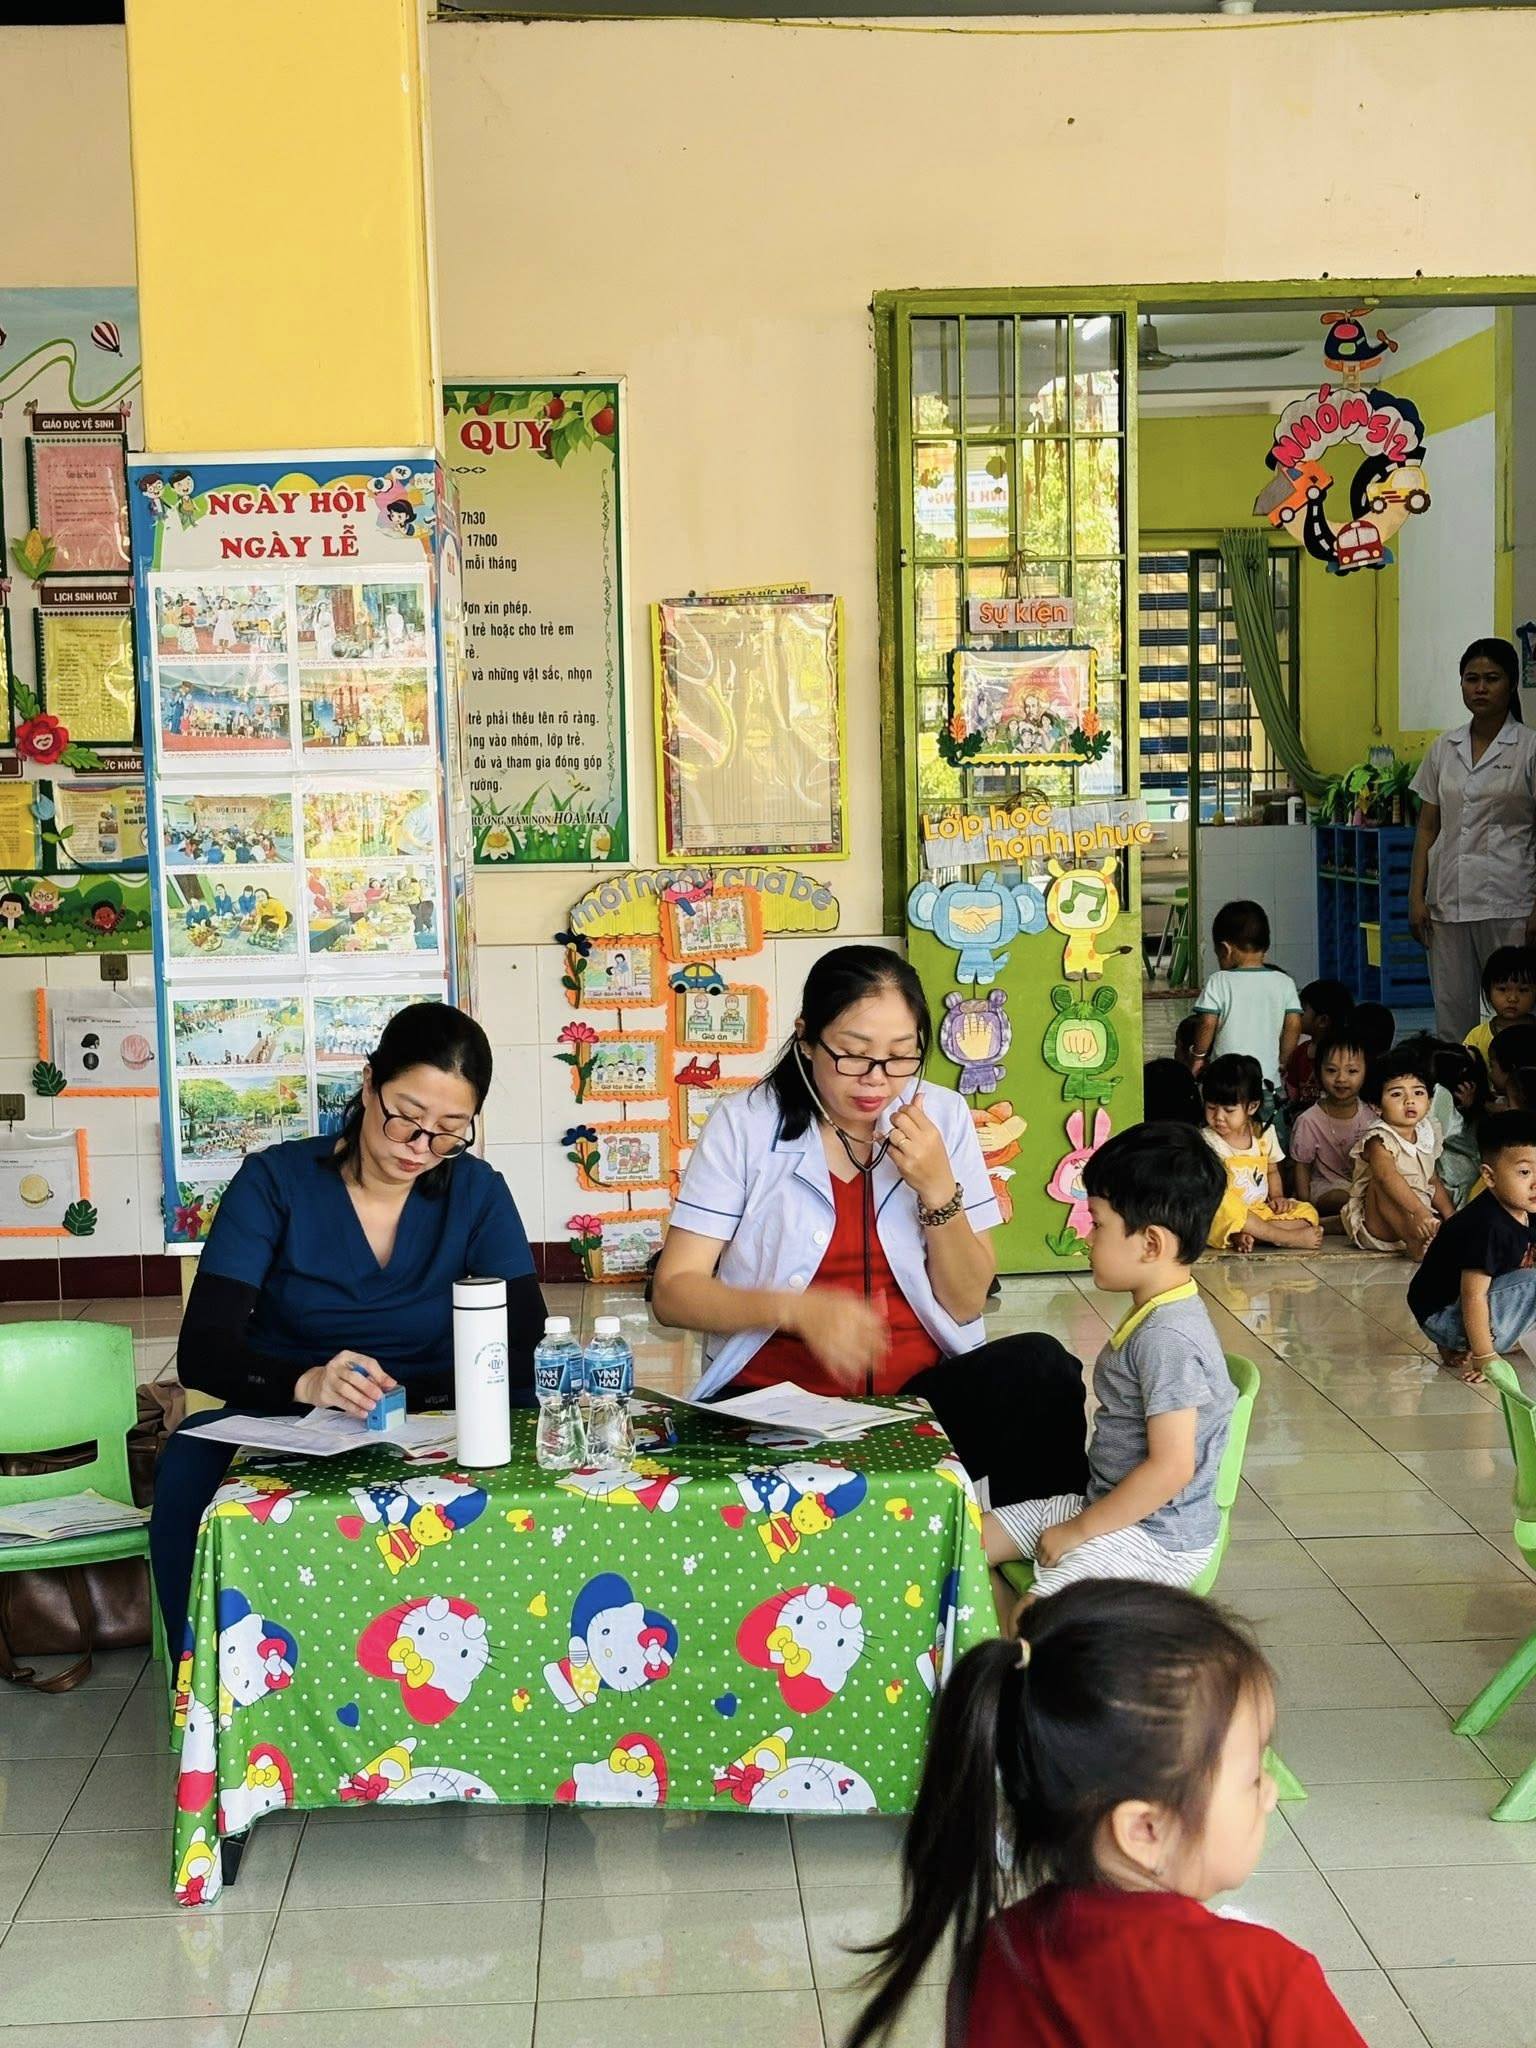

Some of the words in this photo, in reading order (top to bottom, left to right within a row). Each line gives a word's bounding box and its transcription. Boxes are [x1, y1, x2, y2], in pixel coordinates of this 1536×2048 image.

[42, 419, 61, 430] GIÁO
[95, 419, 114, 430] SINH
[460, 420, 551, 456] QUY
[1366, 414, 1408, 462] 5/2
[208, 486, 300, 515] NGÀY
[310, 485, 367, 519] HỘI
[220, 530, 312, 559] NGÀY
[321, 524, 360, 558] LỄ
[467, 533, 498, 547] 17h00
[465, 554, 485, 570] mỗi
[488, 556, 518, 572] tháng
[54, 592, 73, 605] LỊCH
[75, 592, 93, 602] SINH
[95, 591, 118, 604] HOẠT
[484, 601, 499, 614] xin
[503, 600, 532, 617] phép.
[979, 602, 1008, 629] Sự
[1014, 600, 1069, 628] kiện
[472, 621, 487, 637] trẻ
[491, 623, 515, 639] hoặc
[518, 623, 537, 637] cho
[540, 620, 554, 636] trẻ
[558, 625, 574, 636] em
[465, 643, 480, 659] rẻ.
[472, 667, 484, 681] và
[488, 666, 519, 683] những
[523, 667, 539, 683] vật
[542, 664, 564, 682] sắc,
[567, 666, 593, 683] nhọn
[468, 710, 482, 725] trẻ
[486, 710, 508, 727] phải
[512, 711, 535, 725] thêu
[538, 711, 554, 725] tên
[558, 711, 569, 724] rõ
[573, 711, 600, 727] ràng.
[489, 733, 507, 747] vào
[511, 733, 543, 748] nhóm,
[547, 732, 563, 749] lớp
[567, 731, 585, 747] trẻ.
[117, 757, 143, 770] KHỎE
[474, 755, 487, 769] đủ
[491, 755, 502, 769] và
[507, 755, 532, 769] tham
[536, 756, 551, 770] gia
[555, 755, 580, 770] đóng
[583, 754, 602, 770] góp
[470, 778, 503, 793] rường.
[471, 813, 505, 826] RƯỜNG
[531, 815, 551, 825] NON
[553, 811, 581, 825] HOA
[585, 811, 609, 825] MAI
[921, 803, 984, 843] Lớp
[989, 803, 1053, 836] học
[986, 827, 1070, 866] hạnh
[1073, 811, 1154, 858] phúc
[791, 871, 834, 911] bé
